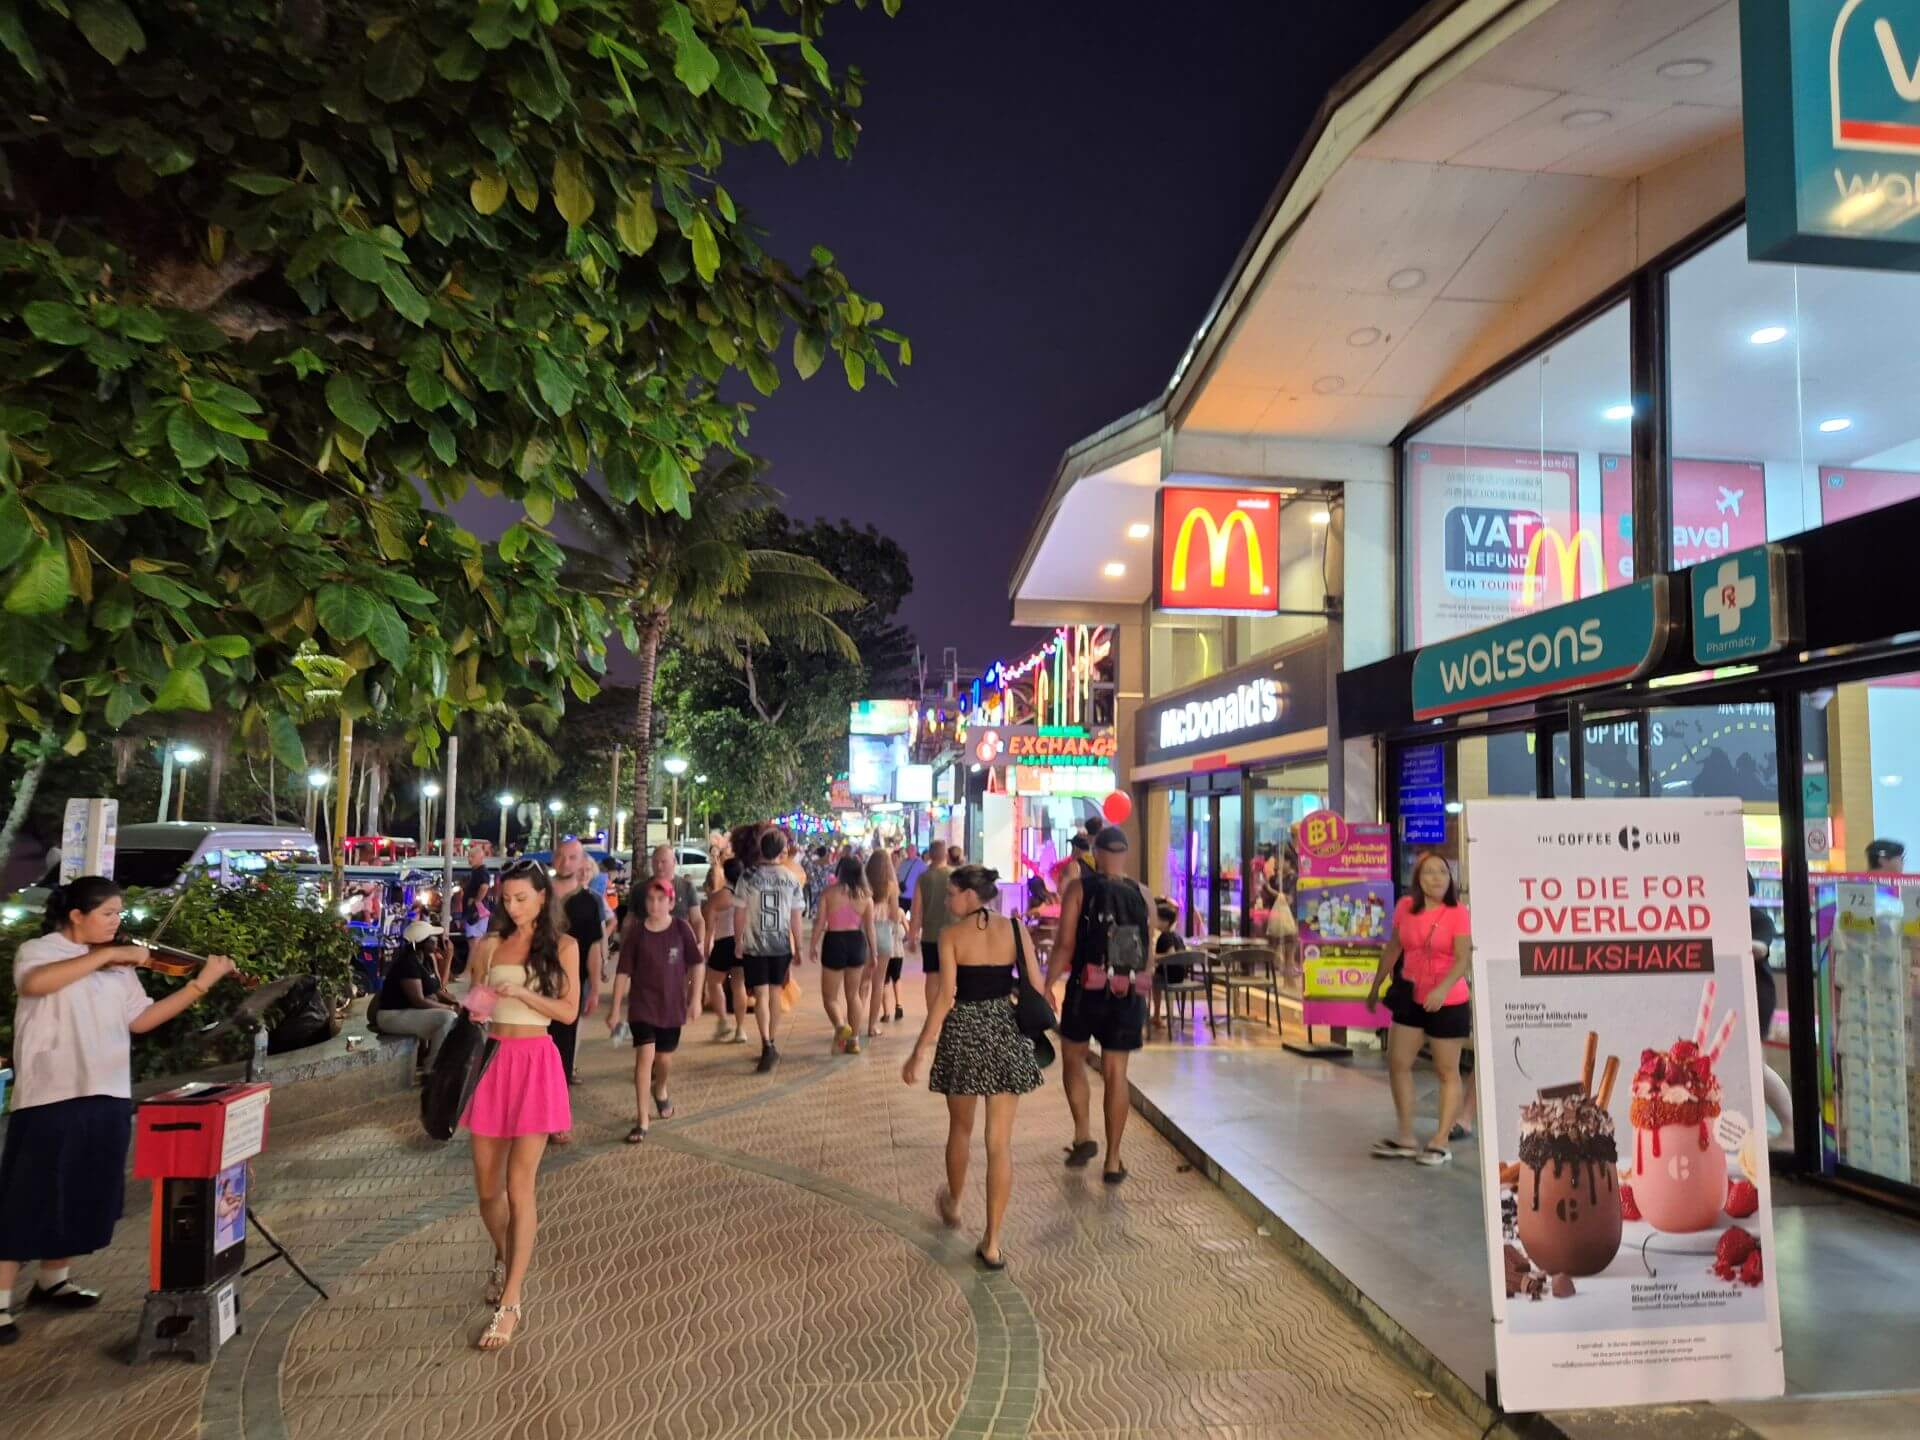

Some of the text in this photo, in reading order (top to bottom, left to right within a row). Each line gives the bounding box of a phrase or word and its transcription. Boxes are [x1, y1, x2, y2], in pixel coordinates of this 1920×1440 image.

[1461, 513, 1533, 550] VAT
[1465, 551, 1530, 569] REFUND
[1450, 578, 1476, 590] FOR
[1706, 634, 1757, 654] Pharmacy
[1439, 618, 1604, 695] watsons
[1160, 679, 1279, 749] McDonald's
[1614, 721, 1664, 747] PICS
[1558, 832, 1612, 846] COFFEE
[1645, 831, 1681, 845] CLUB
[1519, 875, 1706, 901] TO DIE FOR
[1517, 904, 1712, 934] OVERLOAD
[1533, 943, 1703, 972] MILKSHAKE
[1505, 1012, 1588, 1021] Overload Milkshake
[1630, 1282, 1678, 1292] Strawberry
[1663, 1291, 1700, 1302] Overload
[1701, 1289, 1743, 1300] Milkshake
